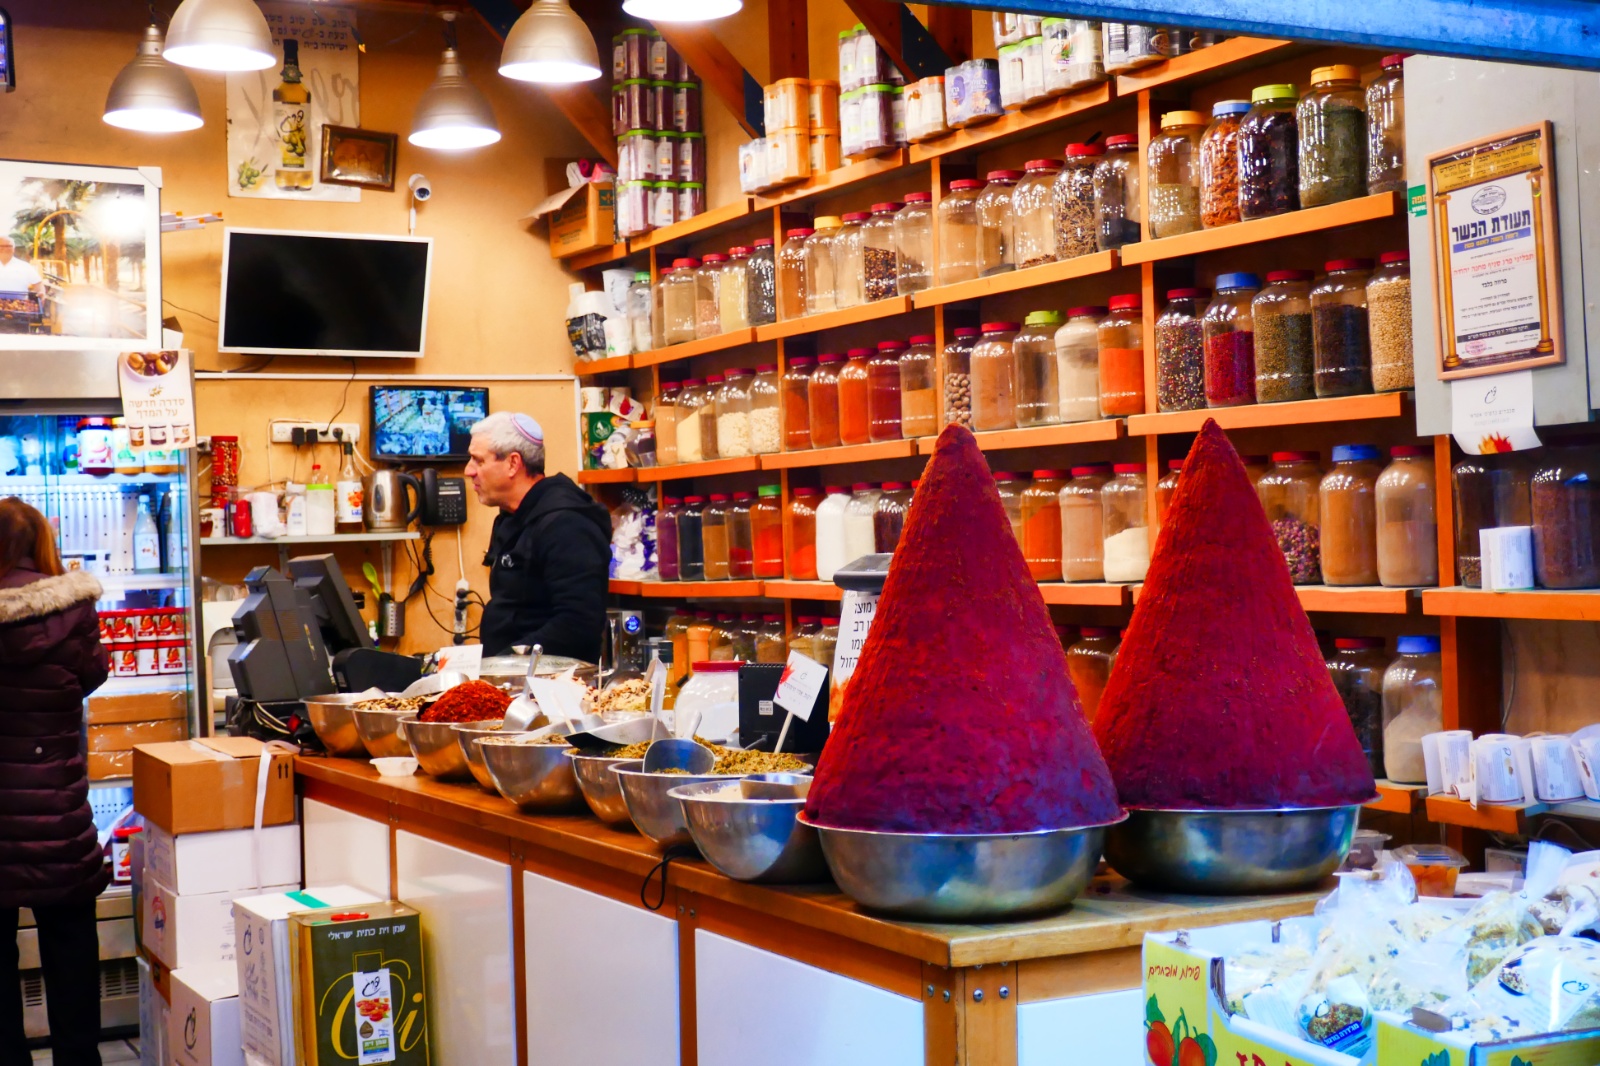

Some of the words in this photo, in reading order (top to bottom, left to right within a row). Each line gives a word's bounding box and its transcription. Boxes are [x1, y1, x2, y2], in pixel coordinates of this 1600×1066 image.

[1491, 209, 1531, 234] תעודת
[1452, 220, 1487, 242] הכשר
[1514, 253, 1534, 263] תבליני
[1472, 263, 1487, 272] מחנה
[1488, 260, 1501, 270] סניף
[129, 399, 157, 408] חדשה
[160, 398, 185, 406] סדרה
[136, 409, 162, 419] המדף
[166, 407, 178, 416] על
[356, 927, 376, 938] כתית
[393, 924, 406, 935] שמן
[328, 930, 354, 941] ישראלי
[1147, 964, 1178, 980] מובחרים
[1179, 964, 1201, 981] פירות
